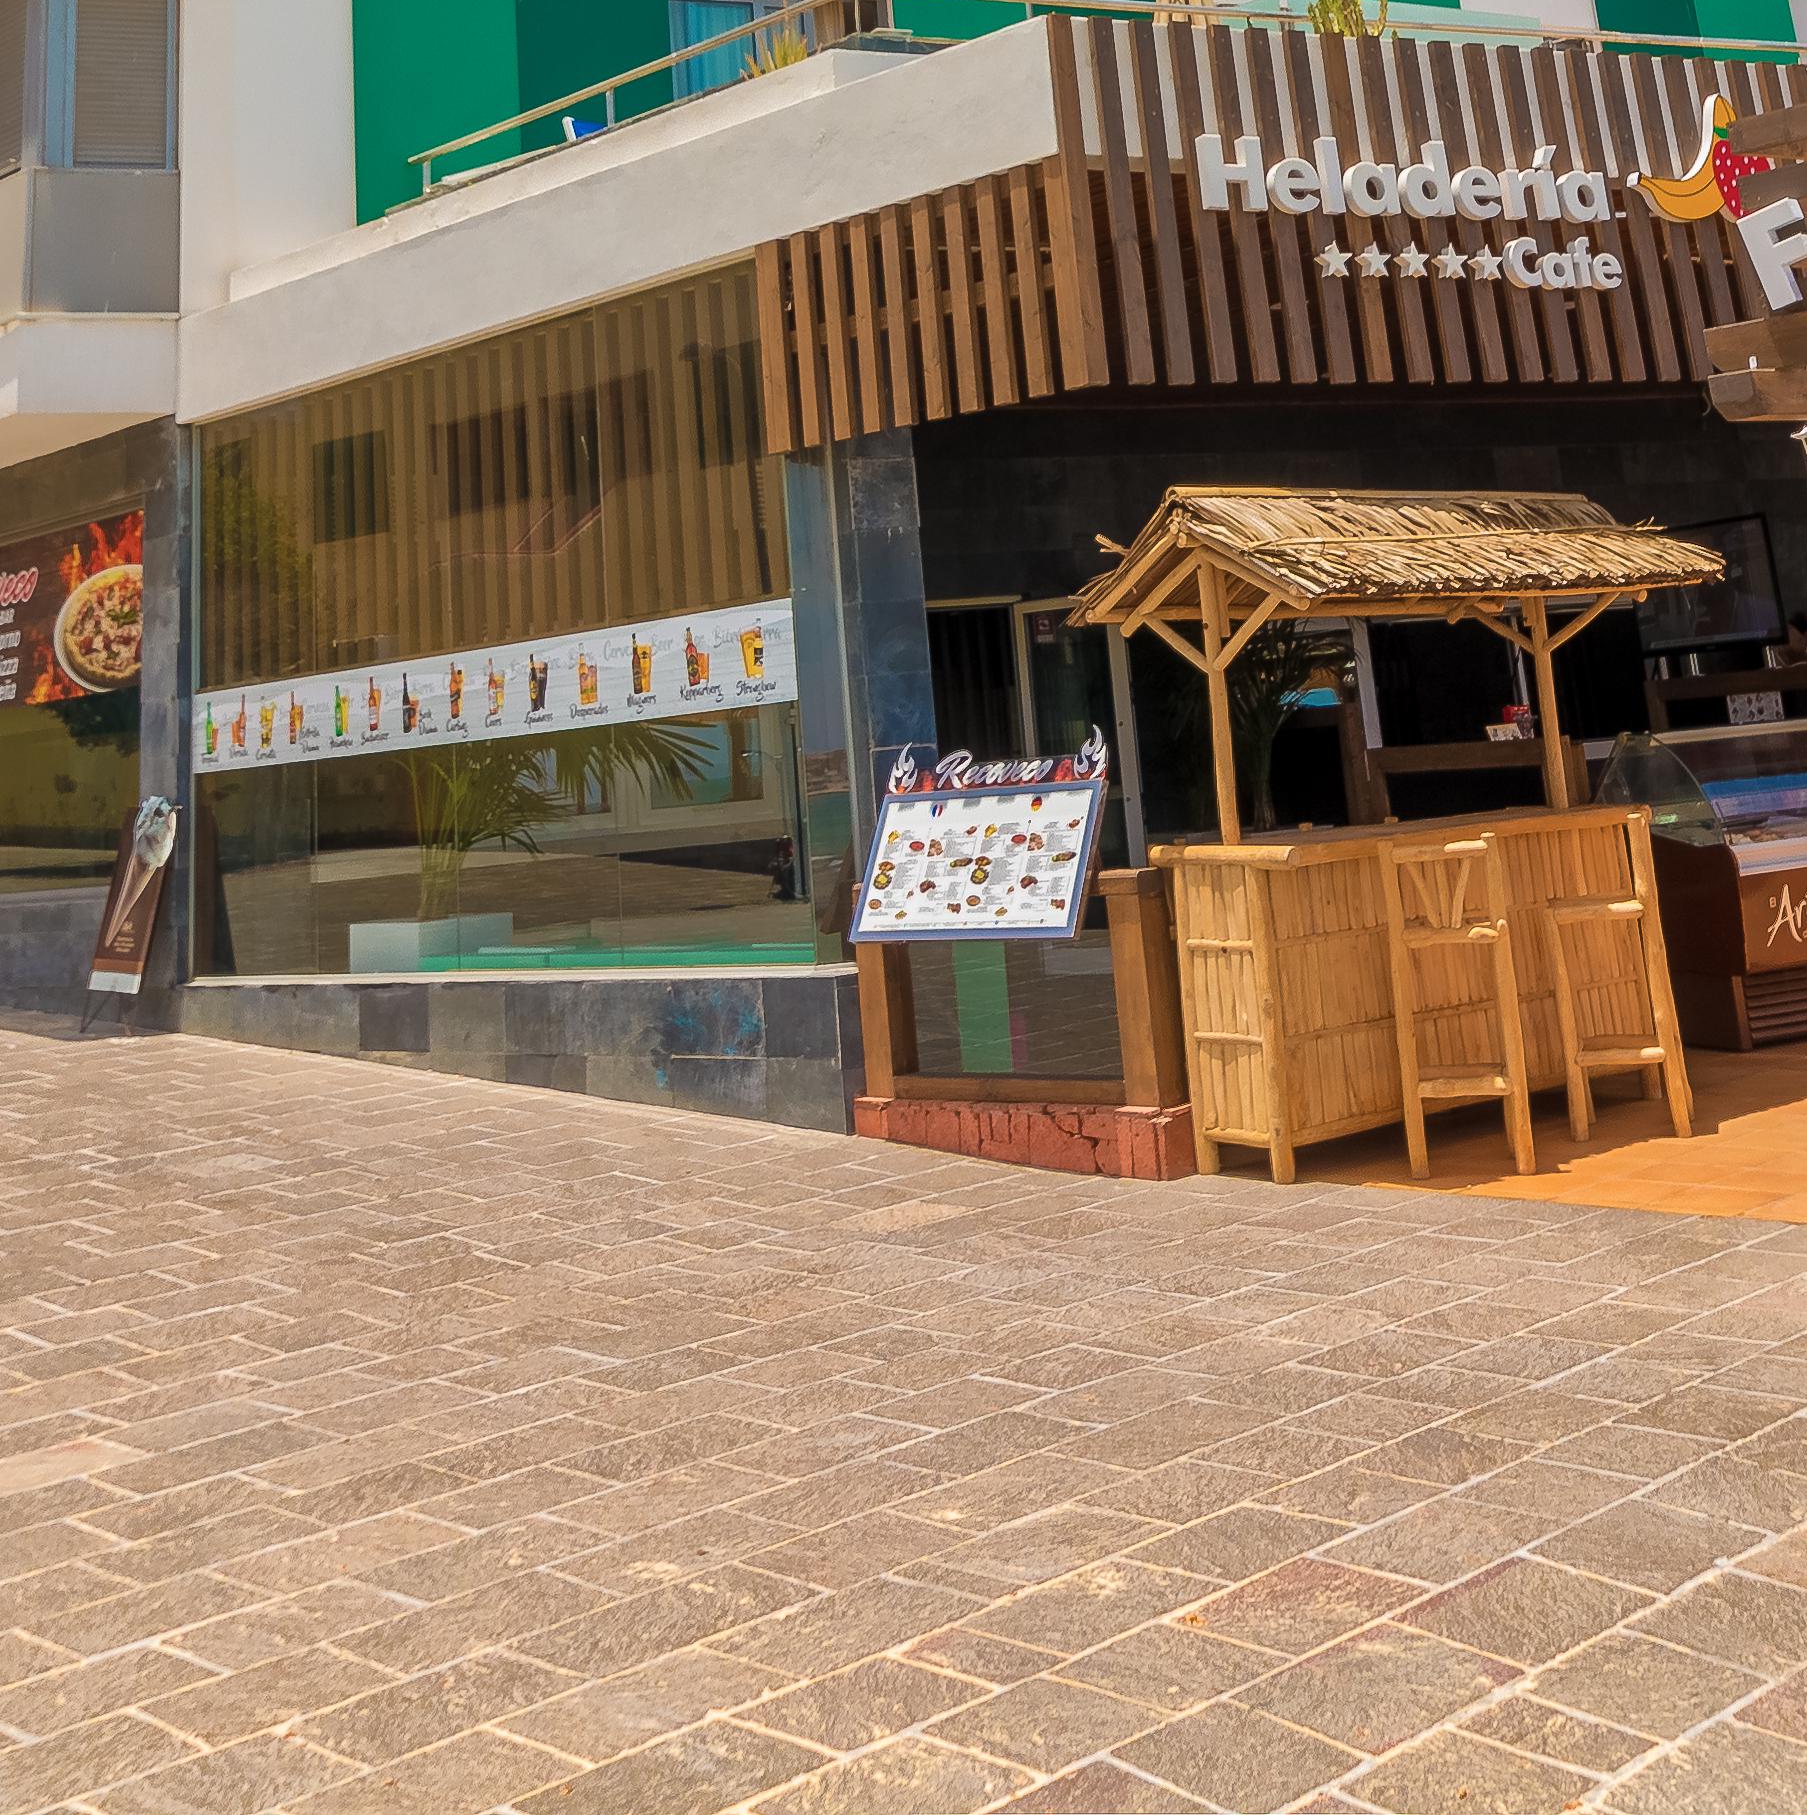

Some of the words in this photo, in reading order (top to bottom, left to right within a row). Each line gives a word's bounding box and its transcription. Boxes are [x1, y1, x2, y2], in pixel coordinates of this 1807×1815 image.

[1195, 134, 1611, 223] Heladería
[1504, 236, 1622, 290] Cafe
[936, 749, 1053, 789] Recoveco
